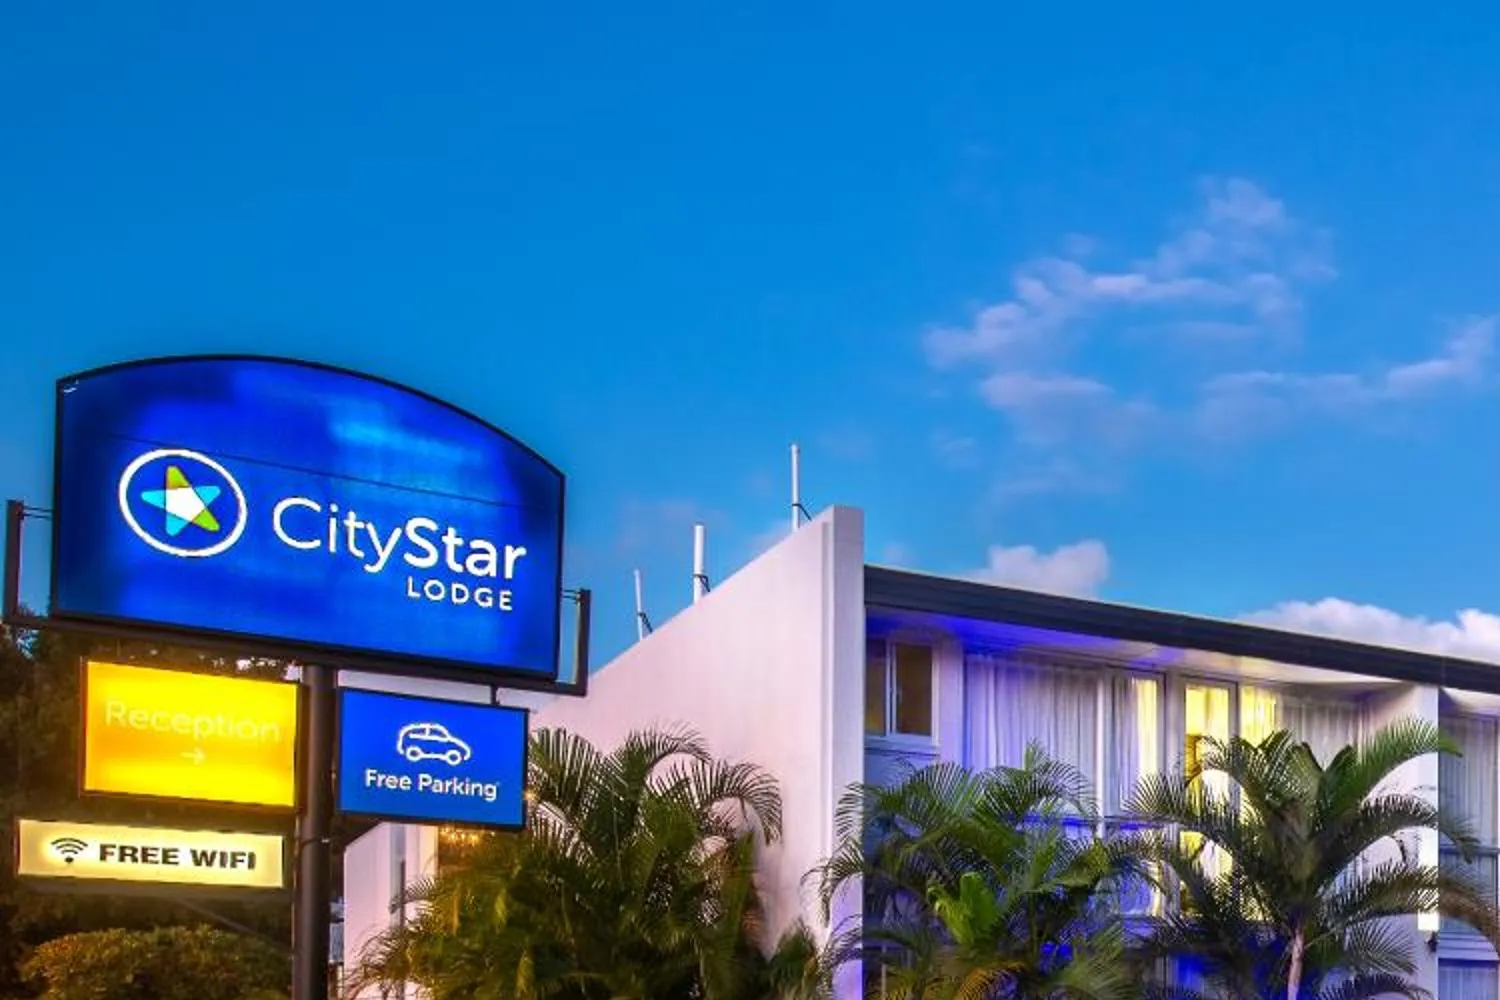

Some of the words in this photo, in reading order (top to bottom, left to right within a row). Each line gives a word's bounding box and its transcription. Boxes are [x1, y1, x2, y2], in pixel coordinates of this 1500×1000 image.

[272, 496, 527, 579] CityStar
[407, 576, 513, 611] LODGE
[105, 700, 281, 743] Reception
[365, 768, 412, 790] Free
[418, 773, 497, 802] Parking
[99, 843, 181, 866] FREE
[190, 848, 257, 870] WIFI
